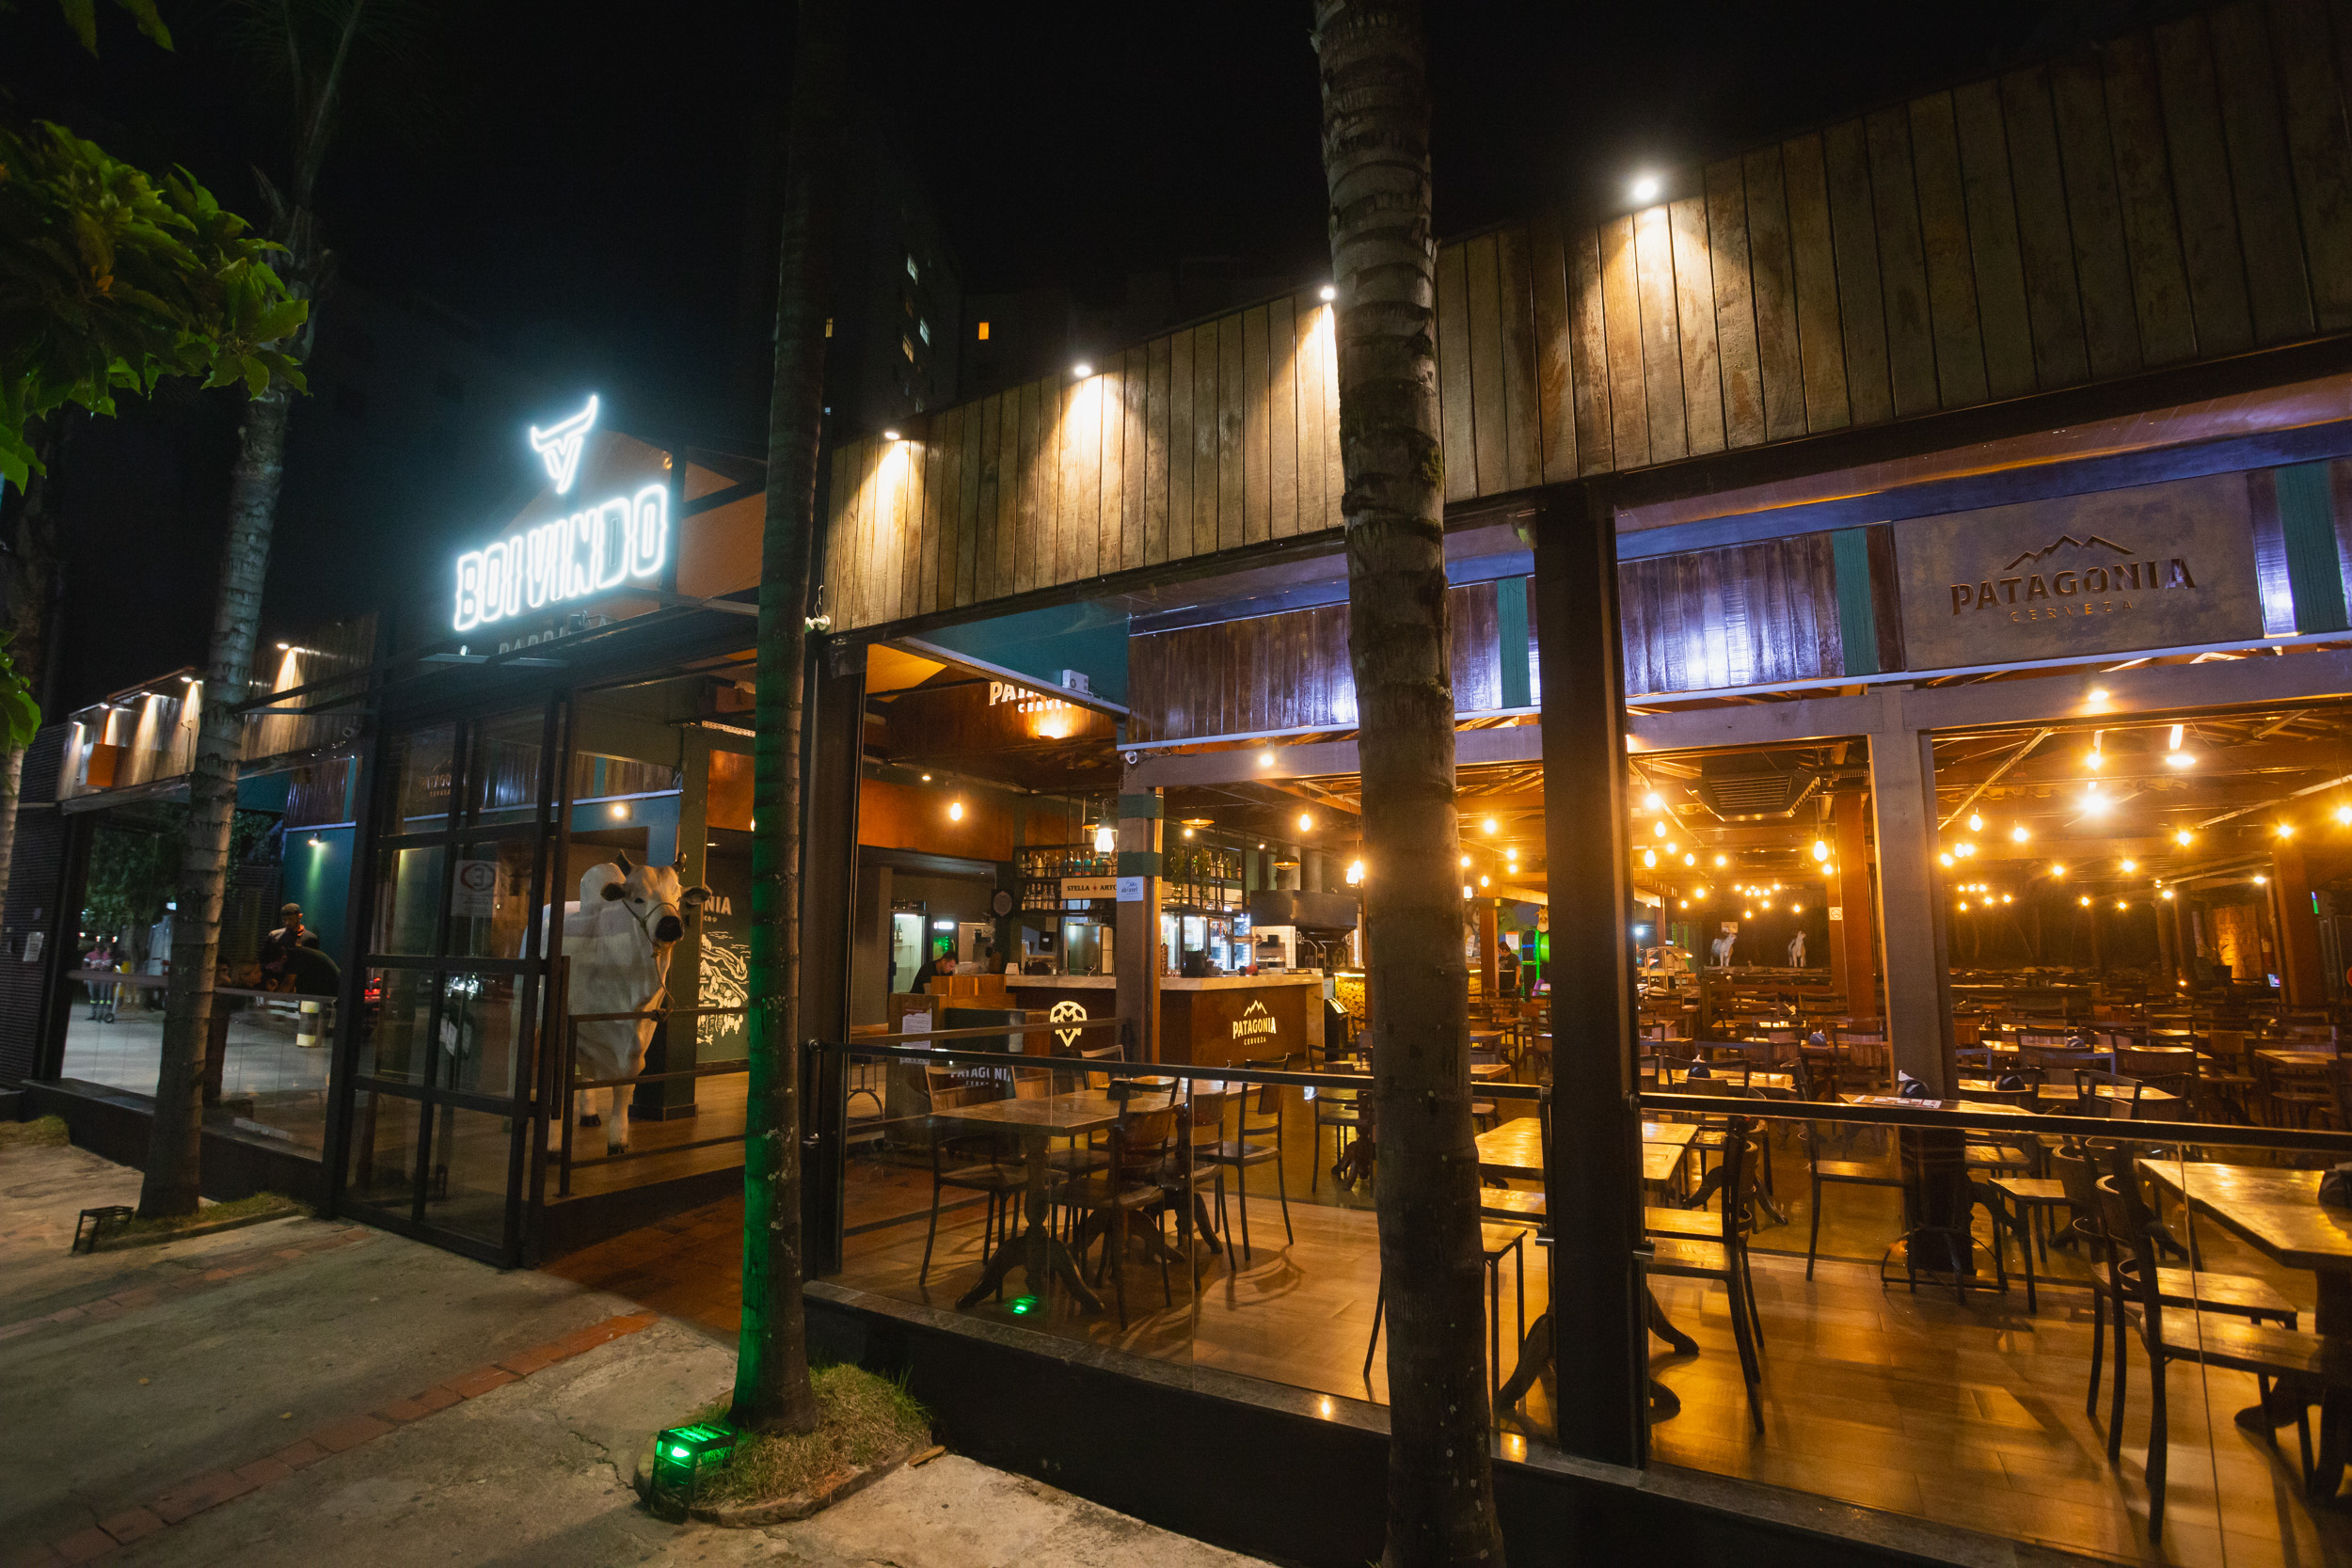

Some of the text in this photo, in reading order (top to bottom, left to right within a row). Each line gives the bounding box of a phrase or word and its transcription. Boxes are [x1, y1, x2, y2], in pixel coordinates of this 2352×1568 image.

[453, 483, 668, 631] BOIVINDO
[1949, 558, 2197, 616] PATAGONIA
[2010, 600, 2133, 623] CERVEZA
[1232, 1016, 1277, 1040] PATAGONIA
[1244, 1036, 1266, 1046] CERVEZA
